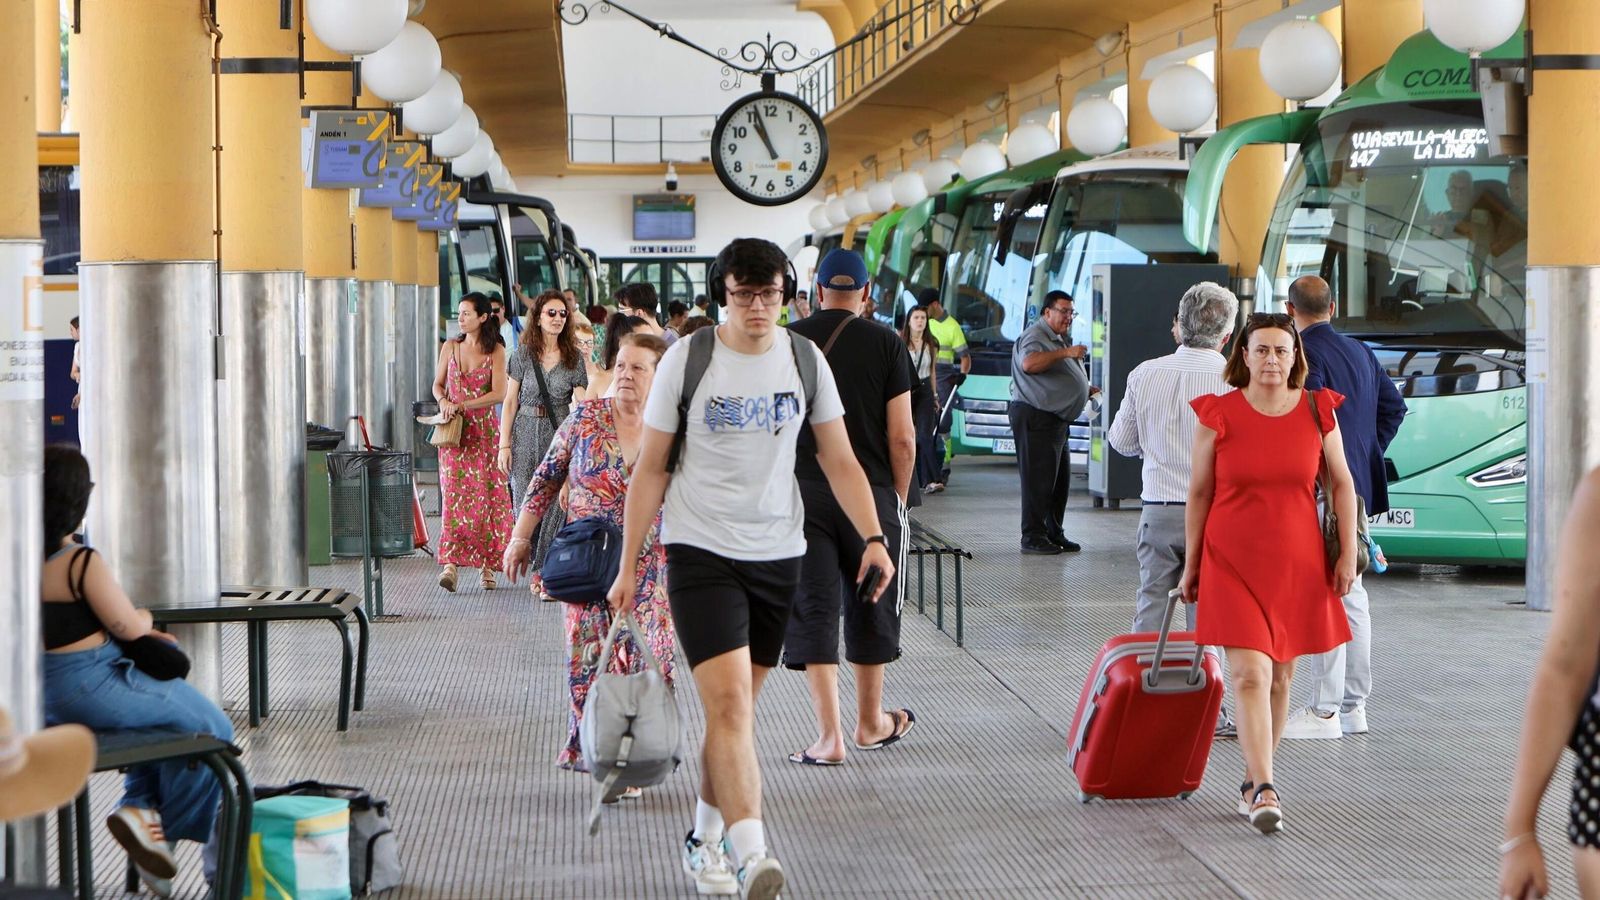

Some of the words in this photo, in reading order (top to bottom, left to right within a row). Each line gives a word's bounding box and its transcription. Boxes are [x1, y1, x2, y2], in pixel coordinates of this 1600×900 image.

[764, 105, 778, 117] 12
[787, 111, 793, 122] 1
[732, 126, 747, 138] 10
[798, 124, 807, 135] 2
[728, 143, 737, 155] 9
[803, 142, 812, 154] 3
[1413, 143, 1433, 160] LA
[1434, 142, 1477, 159] LINEA
[1350, 149, 1380, 168] 147
[733, 161, 742, 173] 8
[798, 160, 807, 172] 4
[749, 175, 758, 187] 7
[766, 180, 775, 192] 6
[785, 175, 794, 187] 5
[1502, 396, 1525, 409] 612
[1000, 441, 1015, 450] 792
[1387, 510, 1411, 525] MSC
